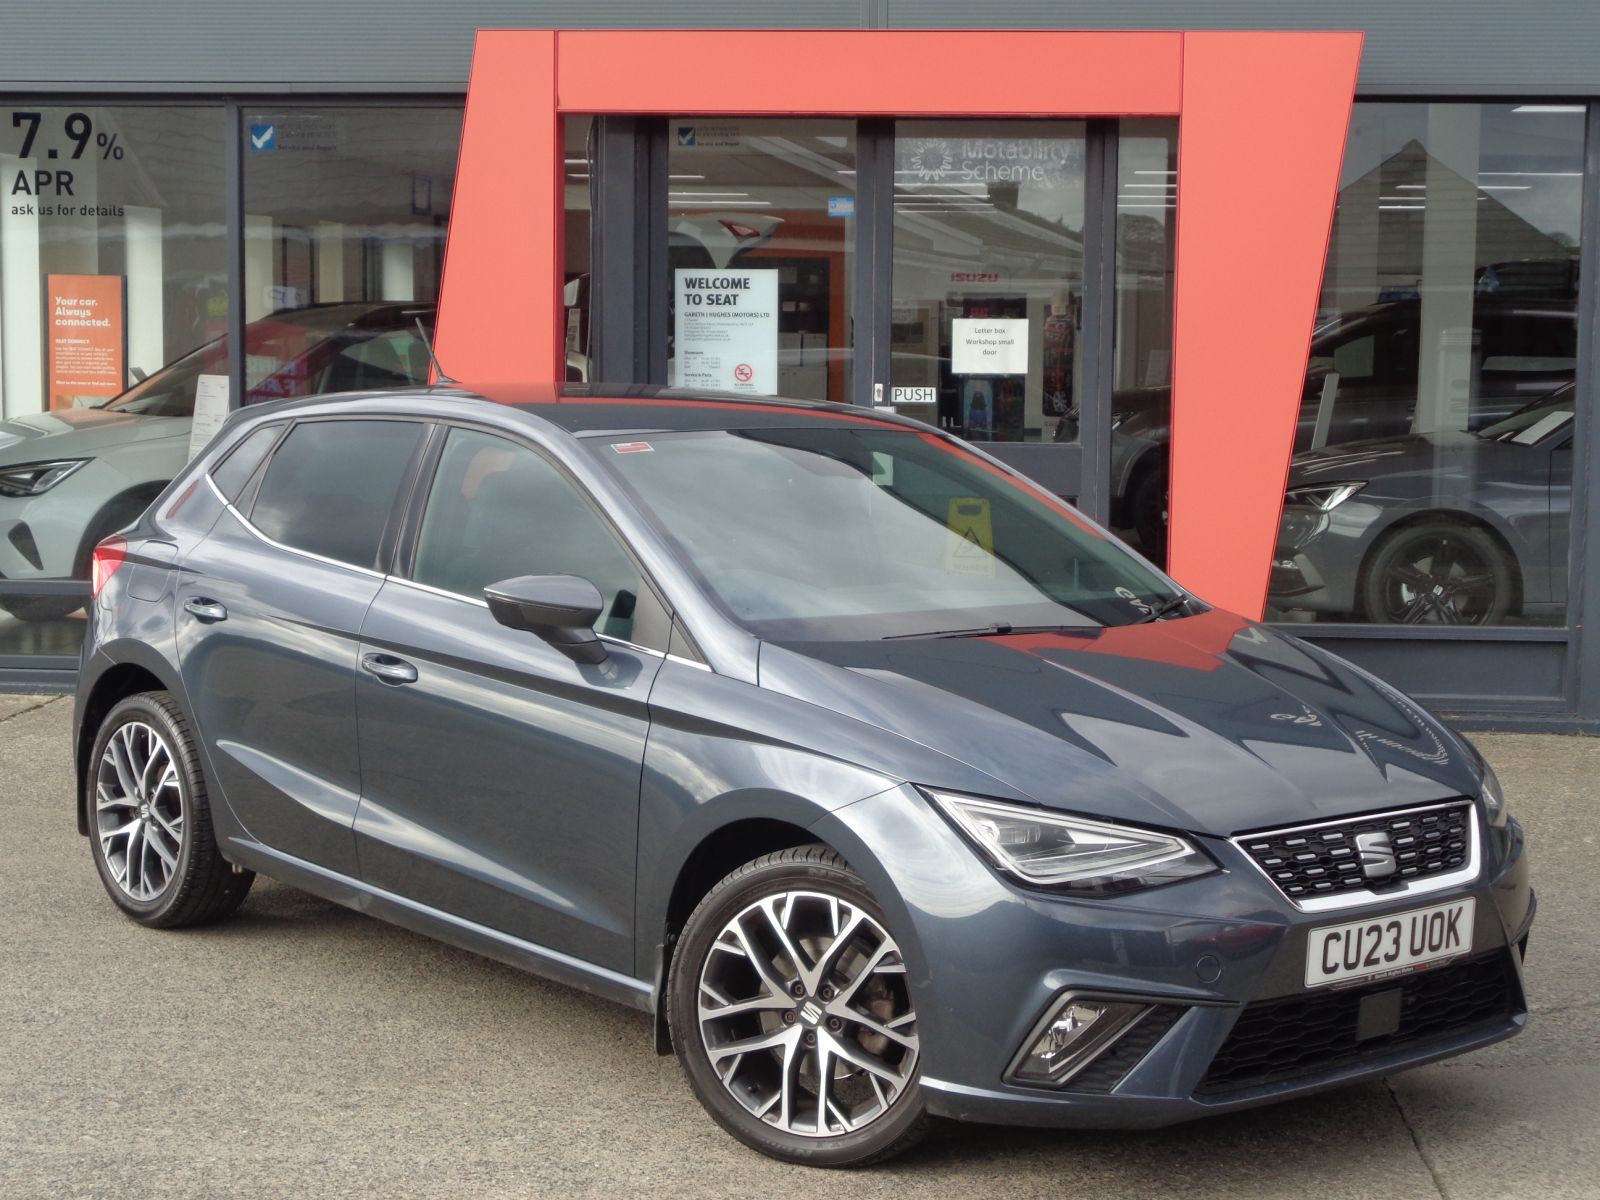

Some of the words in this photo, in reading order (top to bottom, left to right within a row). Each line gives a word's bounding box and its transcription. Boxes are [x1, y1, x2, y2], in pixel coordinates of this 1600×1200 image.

[962, 140, 1069, 165] Motability
[962, 161, 1045, 180] Scheme
[11, 170, 74, 196] APR
[11, 204, 34, 215] ask
[38, 206, 54, 215] us
[57, 204, 76, 216] for
[80, 205, 125, 217] details
[684, 277, 750, 290] WELCOME
[951, 273, 998, 282] ISUZU
[56, 297, 77, 306] Your
[684, 294, 702, 305] TO
[706, 294, 739, 305] SEAT
[55, 307, 91, 318] Always
[55, 318, 111, 327] connected.
[965, 338, 997, 346] Workshop
[894, 389, 933, 401] PUSH
[1322, 921, 1402, 975] CU23
[1410, 906, 1463, 957] UOK
